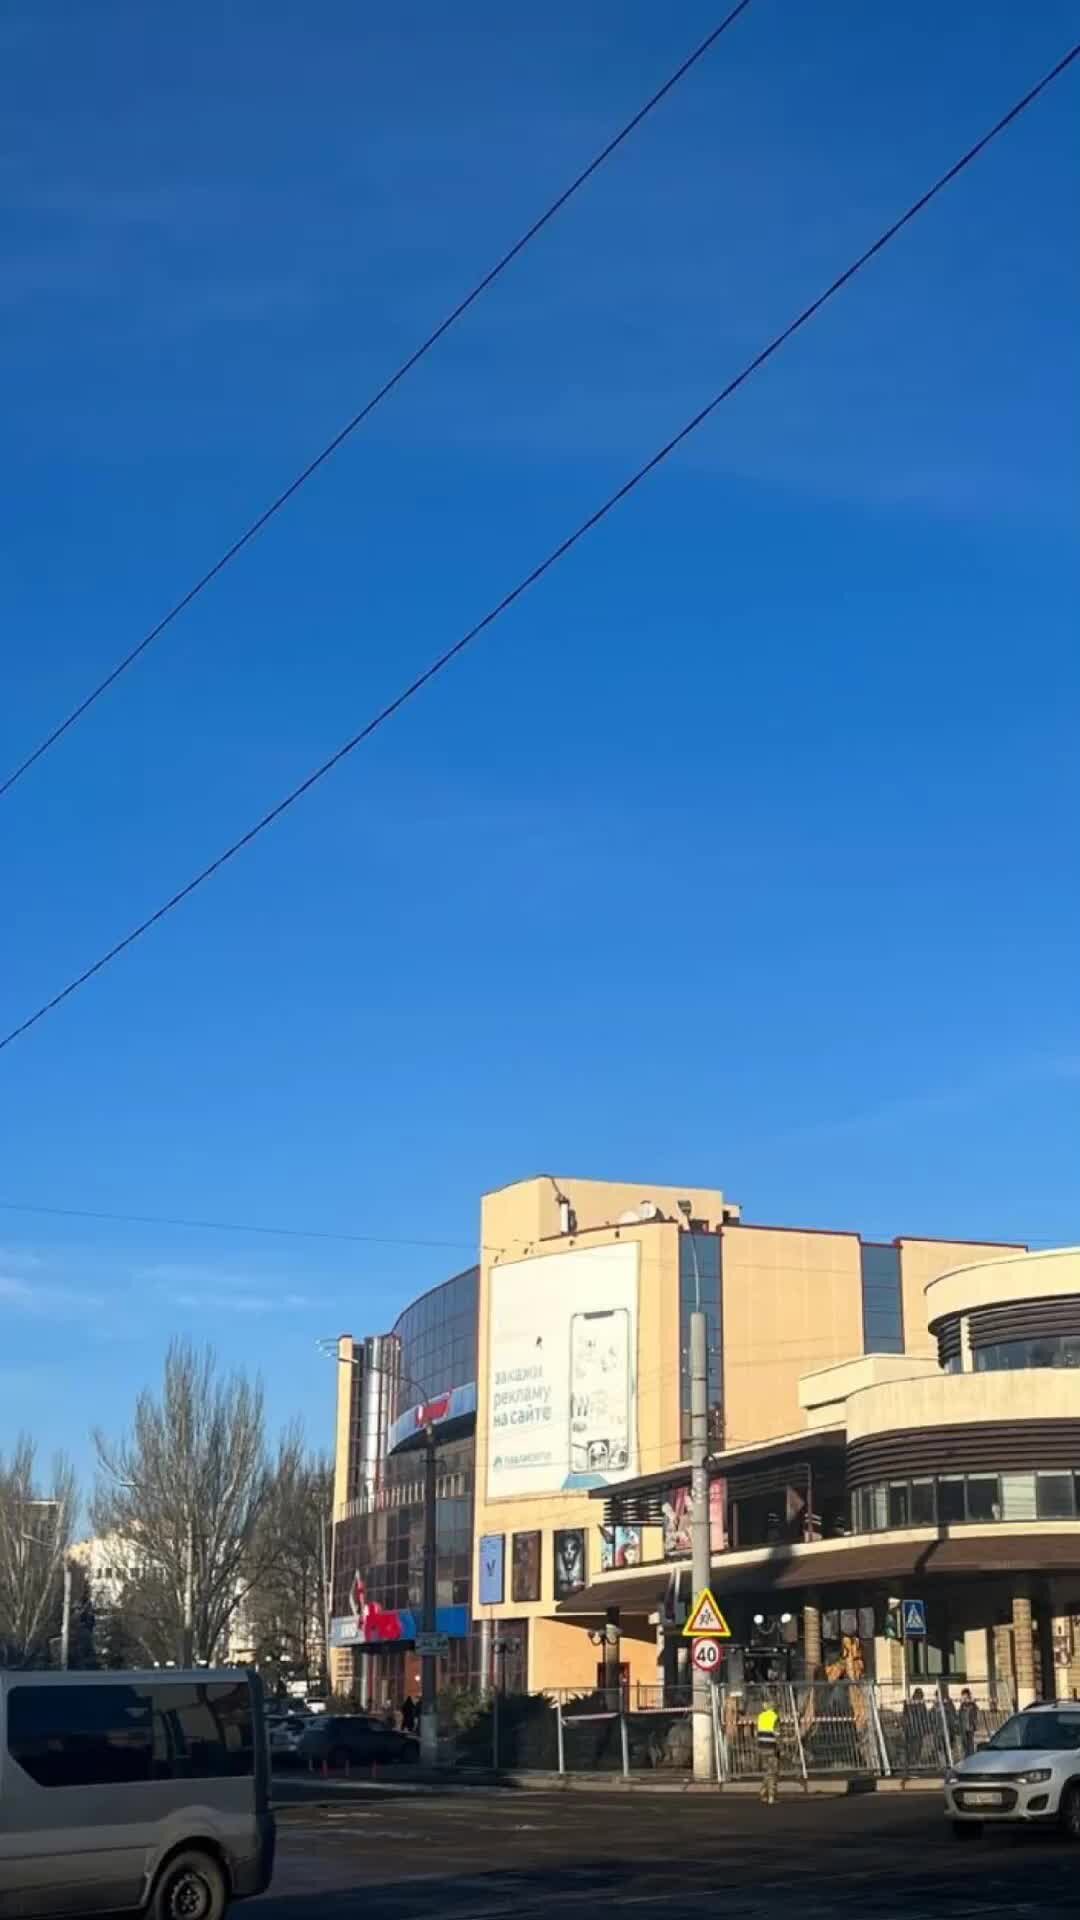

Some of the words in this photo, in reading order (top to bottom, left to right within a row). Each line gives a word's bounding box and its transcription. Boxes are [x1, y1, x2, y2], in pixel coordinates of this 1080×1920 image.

[493, 1386, 551, 1411] рекламу
[493, 1412, 508, 1427] на
[510, 1403, 551, 1424] сайте
[697, 1647, 716, 1662] 40
